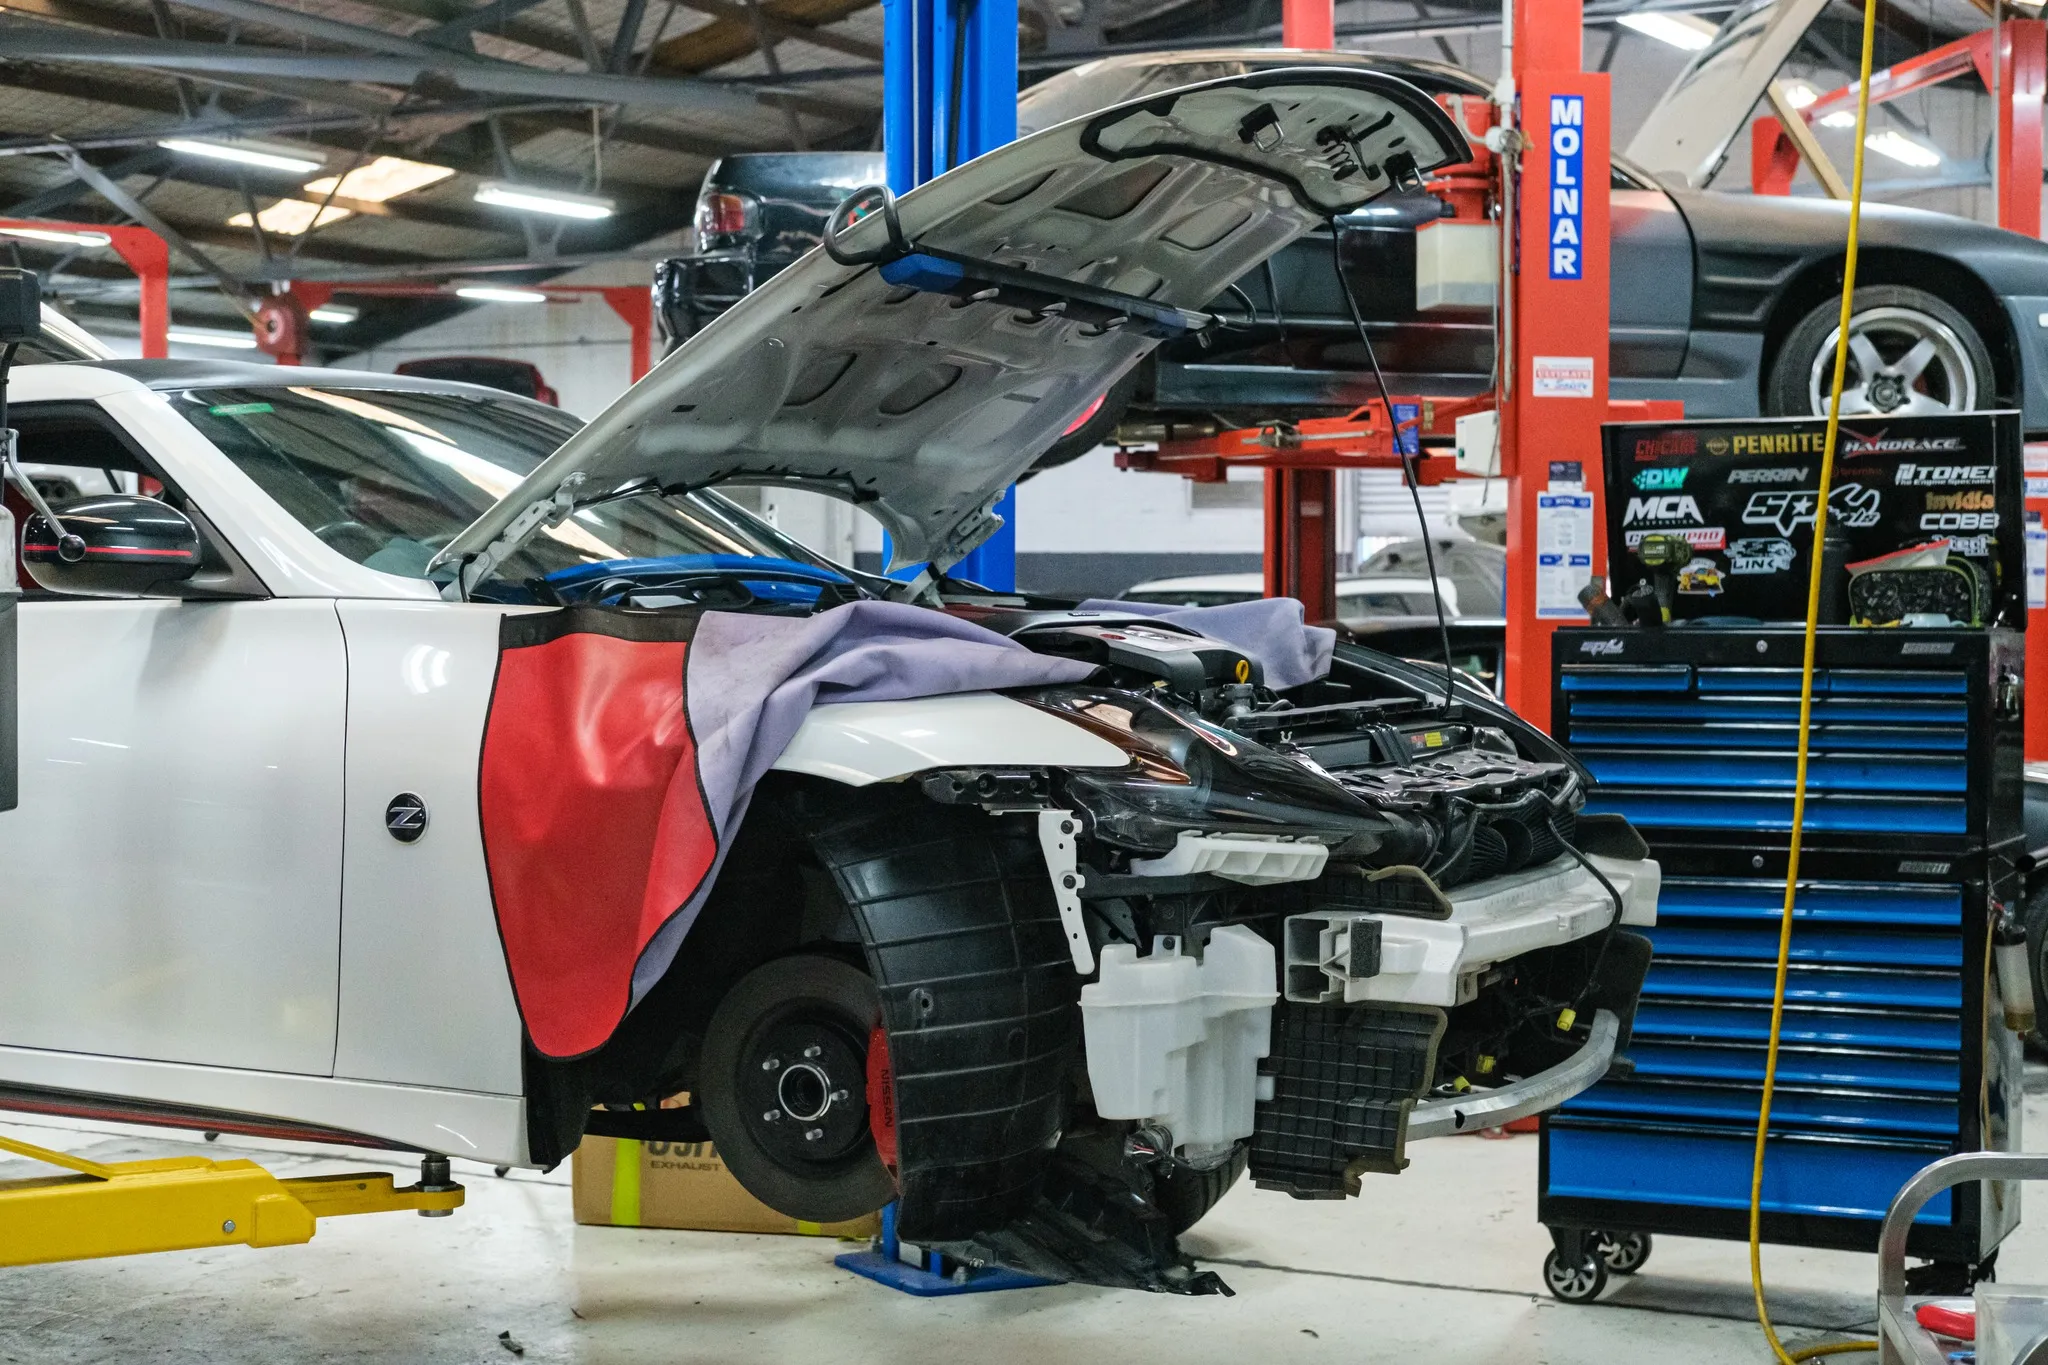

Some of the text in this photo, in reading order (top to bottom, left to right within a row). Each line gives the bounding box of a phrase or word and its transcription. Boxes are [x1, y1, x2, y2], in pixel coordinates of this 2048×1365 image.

[1551, 98, 1582, 274] MOLNAR
[1733, 432, 1825, 455] PENRITE
[1844, 438, 1958, 453] HARDRACE
[1645, 466, 1689, 486] DW
[1727, 467, 1809, 484] PERRIN
[1622, 495, 1704, 527] MCA
[1920, 513, 2000, 530] COBB
[880, 1069, 894, 1128] NISSAN
[651, 1160, 722, 1172] EXHAUST
